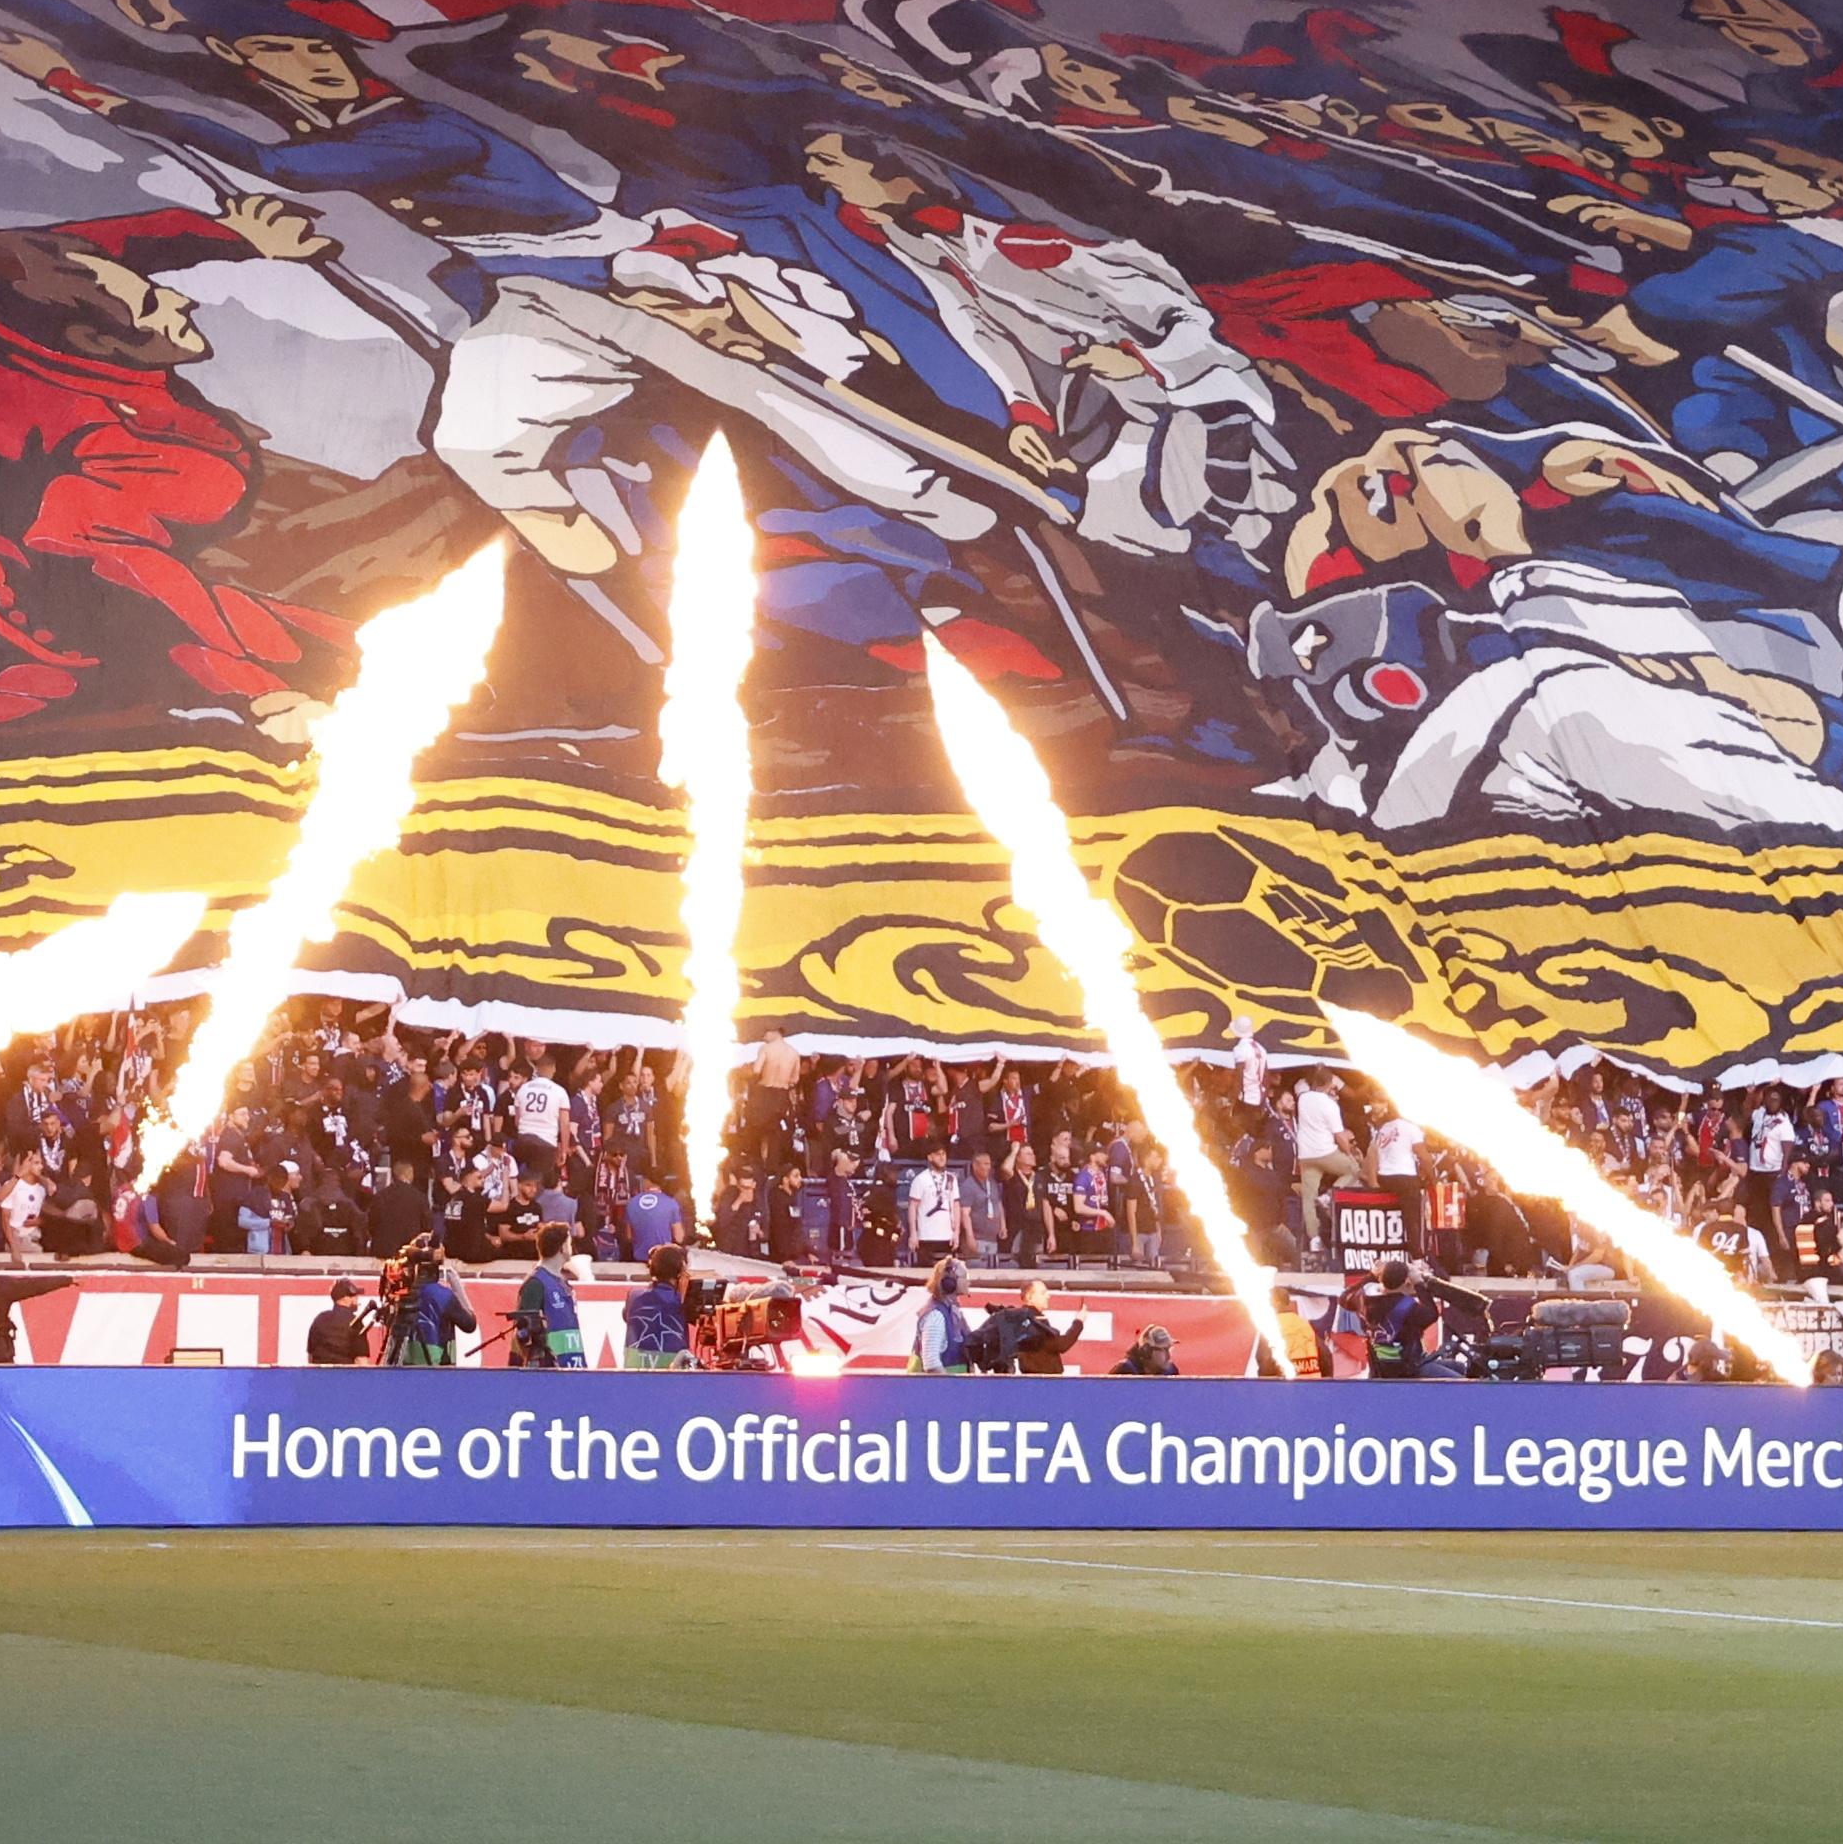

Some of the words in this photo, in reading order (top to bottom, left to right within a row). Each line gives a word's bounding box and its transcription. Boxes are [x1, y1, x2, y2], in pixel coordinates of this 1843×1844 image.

[525, 1092, 548, 1113] 29
[1711, 1231, 1740, 1255] 94
[565, 1332, 580, 1350] TV
[639, 1353, 659, 1367] TV
[232, 1412, 442, 1479] Home
[458, 1410, 536, 1479] of
[544, 1414, 661, 1481] the
[676, 1412, 908, 1483] Official
[927, 1420, 1092, 1484] UEFA
[1106, 1421, 1458, 1500] Champions
[1474, 1425, 1688, 1503] League
